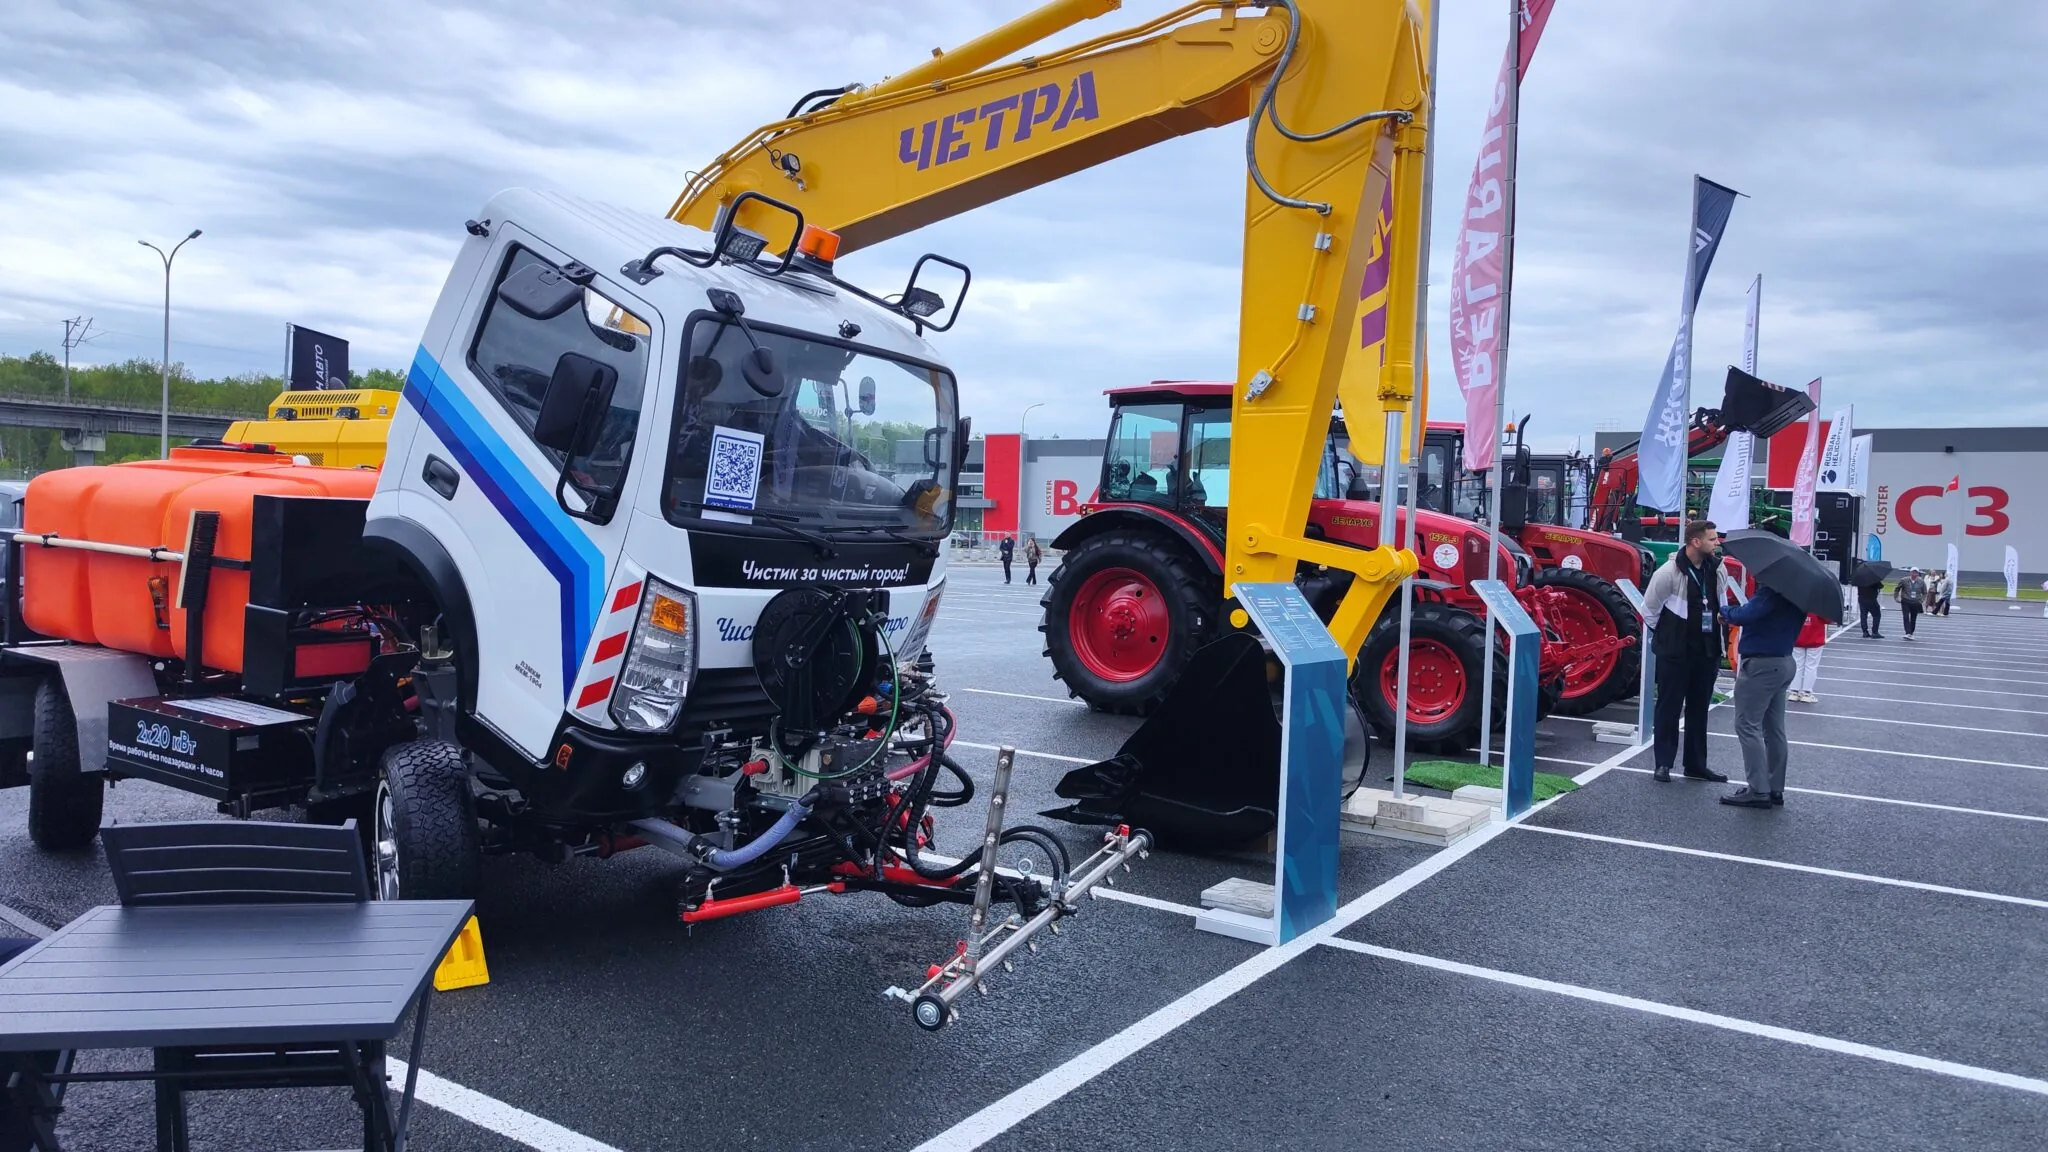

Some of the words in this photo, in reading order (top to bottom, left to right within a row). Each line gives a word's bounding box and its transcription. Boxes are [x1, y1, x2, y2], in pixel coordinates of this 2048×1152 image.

[899, 71, 1099, 171] ЧЕТРА
[315, 344, 324, 380] АВТО
[1824, 434, 1837, 467] RUSSIAN
[1832, 416, 1845, 467] HELICOPTERS
[1045, 479, 1053, 516] CLUSTER
[1876, 485, 1889, 535] CLUSTER
[1332, 516, 1374, 528] БЕЛАРУС
[742, 560, 799, 581] Чистик
[801, 568, 817, 581] за
[821, 563, 869, 582] чистый
[870, 562, 910, 586] город!
[109, 740, 127, 754] Время
[127, 746, 149, 760] работы
[149, 751, 160, 762] без
[160, 754, 196, 772] подзарядки
[205, 766, 224, 778] часов
[172, 730, 197, 756] кВт
